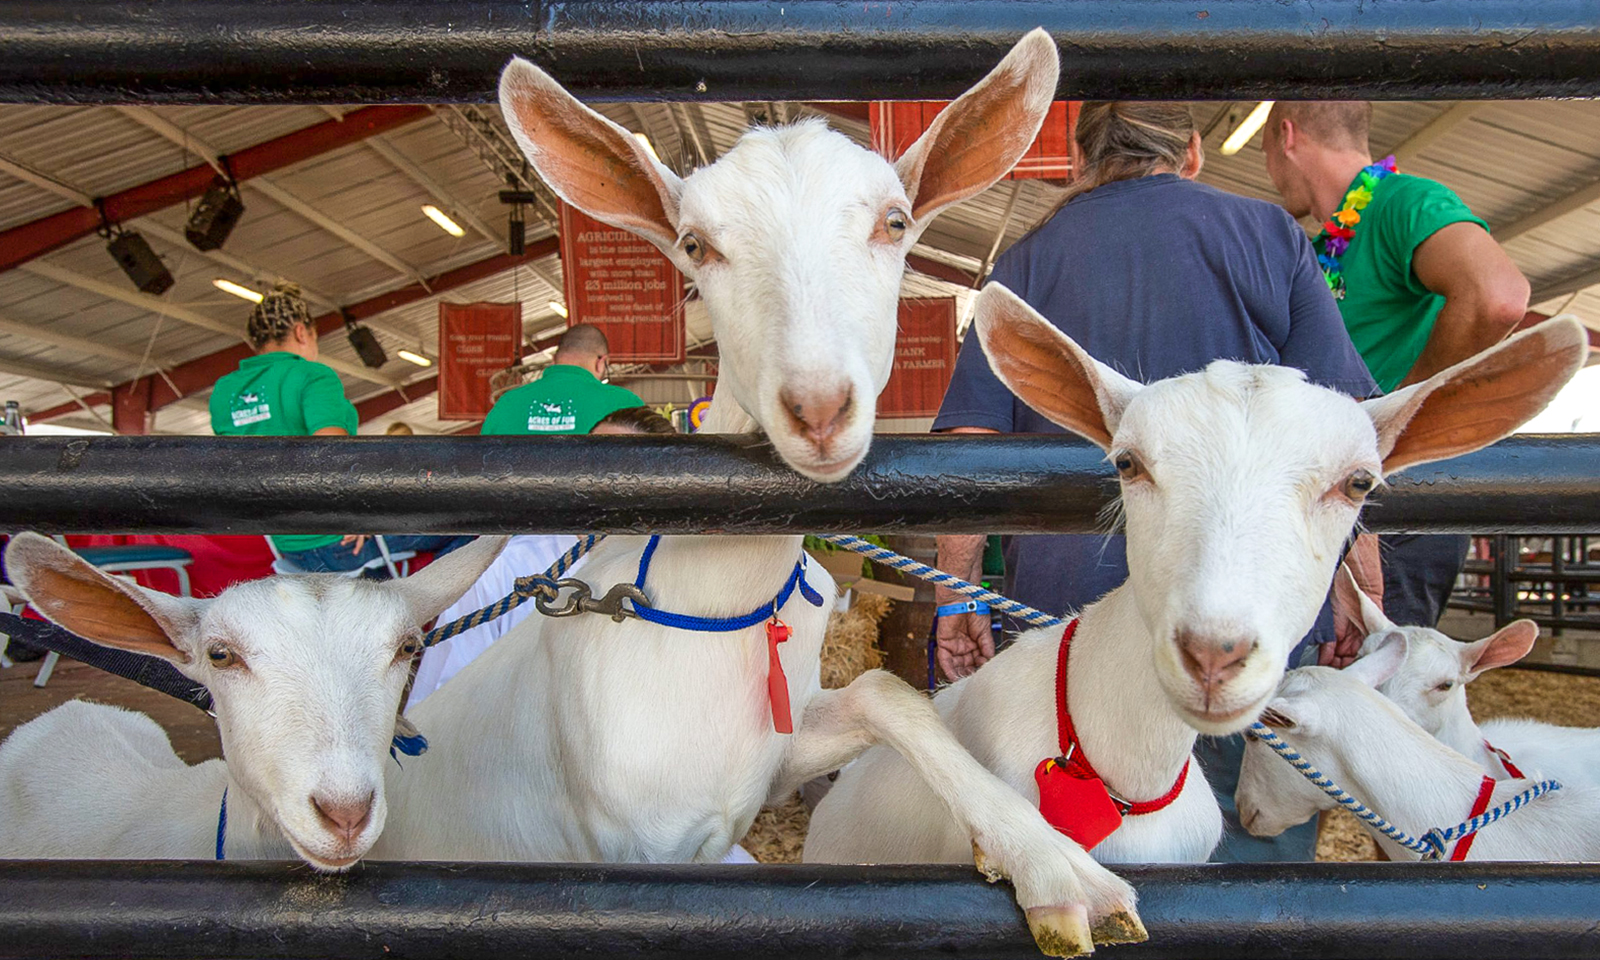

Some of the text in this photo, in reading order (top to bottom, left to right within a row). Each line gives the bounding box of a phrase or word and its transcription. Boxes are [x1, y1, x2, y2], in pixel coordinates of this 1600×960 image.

[577, 231, 645, 242] AGRICULT
[599, 245, 616, 254] the
[579, 257, 614, 268] largest
[588, 269, 609, 277] with
[634, 269, 656, 277] than
[585, 279, 666, 292] 23 million jobs
[587, 294, 624, 302] involved
[633, 302, 653, 311] facet
[655, 302, 664, 310] of
[581, 314, 622, 323] American
[895, 347, 925, 356] HANK
[903, 359, 946, 369] FARMER
